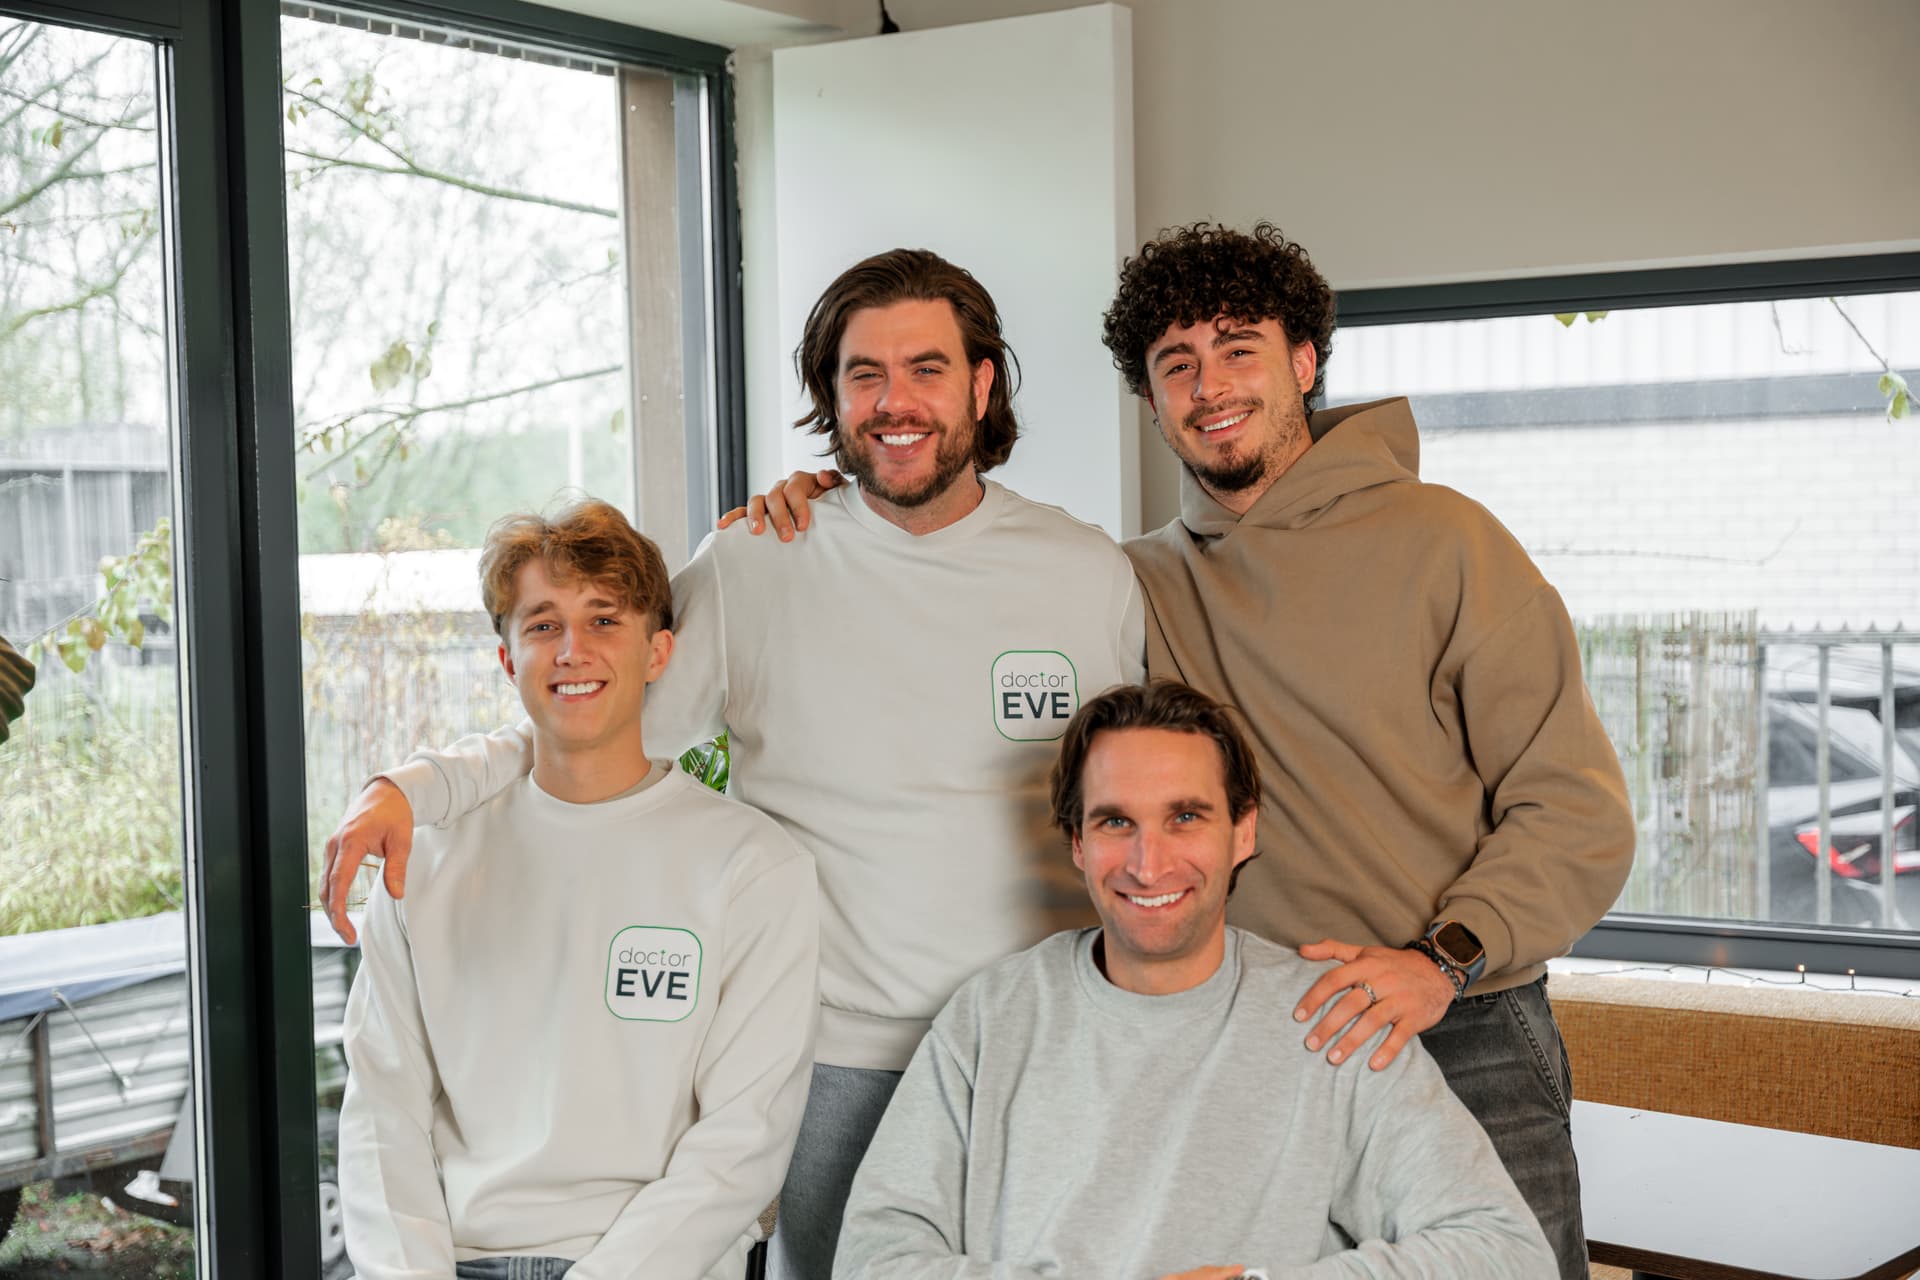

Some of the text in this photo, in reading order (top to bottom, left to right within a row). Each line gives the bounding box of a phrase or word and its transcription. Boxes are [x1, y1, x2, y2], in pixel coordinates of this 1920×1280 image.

[1001, 671, 1069, 688] doctor
[1002, 691, 1070, 719] EVE
[618, 946, 692, 968] doctor
[615, 968, 690, 1001] EVE
